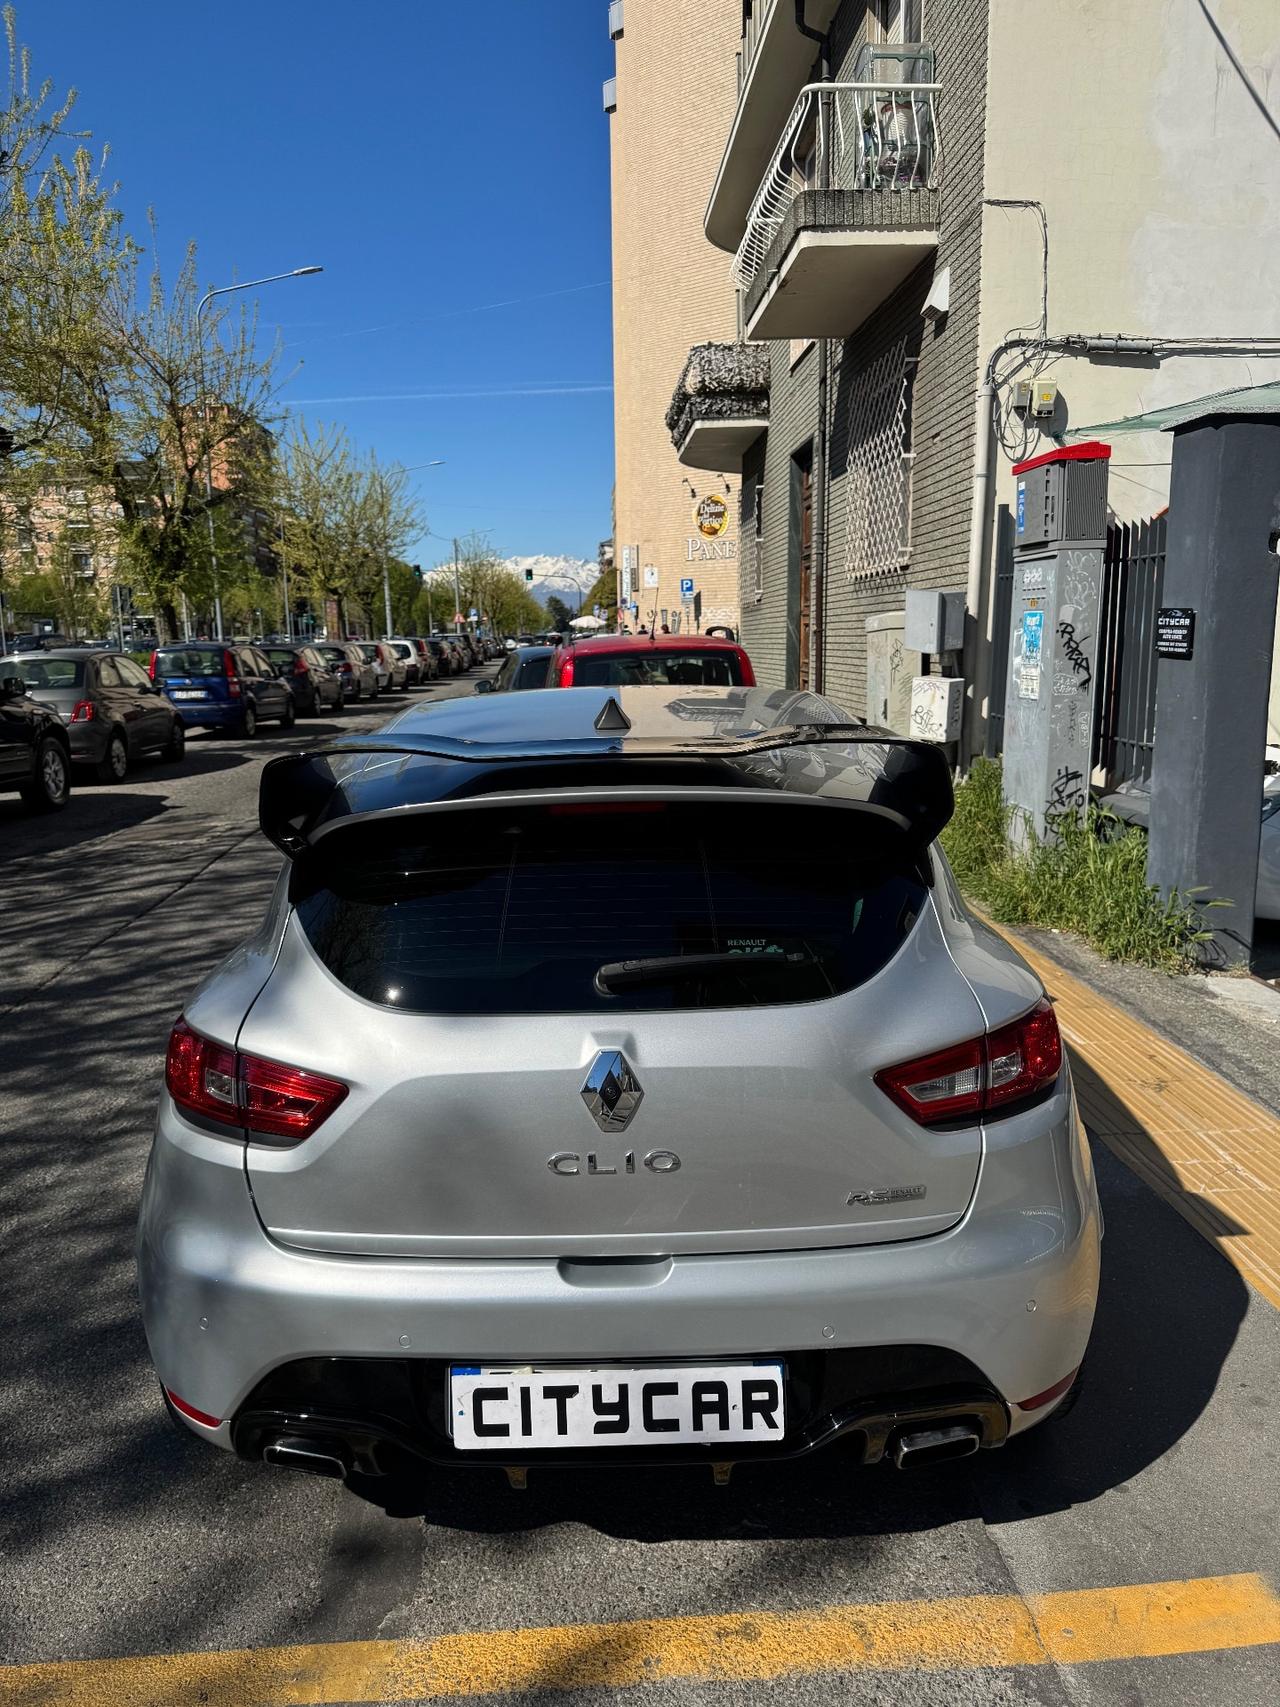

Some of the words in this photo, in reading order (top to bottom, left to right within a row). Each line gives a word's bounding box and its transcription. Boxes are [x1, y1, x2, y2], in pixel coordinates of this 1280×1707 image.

[683, 580, 691, 591] P
[547, 1148, 682, 1176] CLIO
[472, 1380, 779, 1438] CITYCAR
